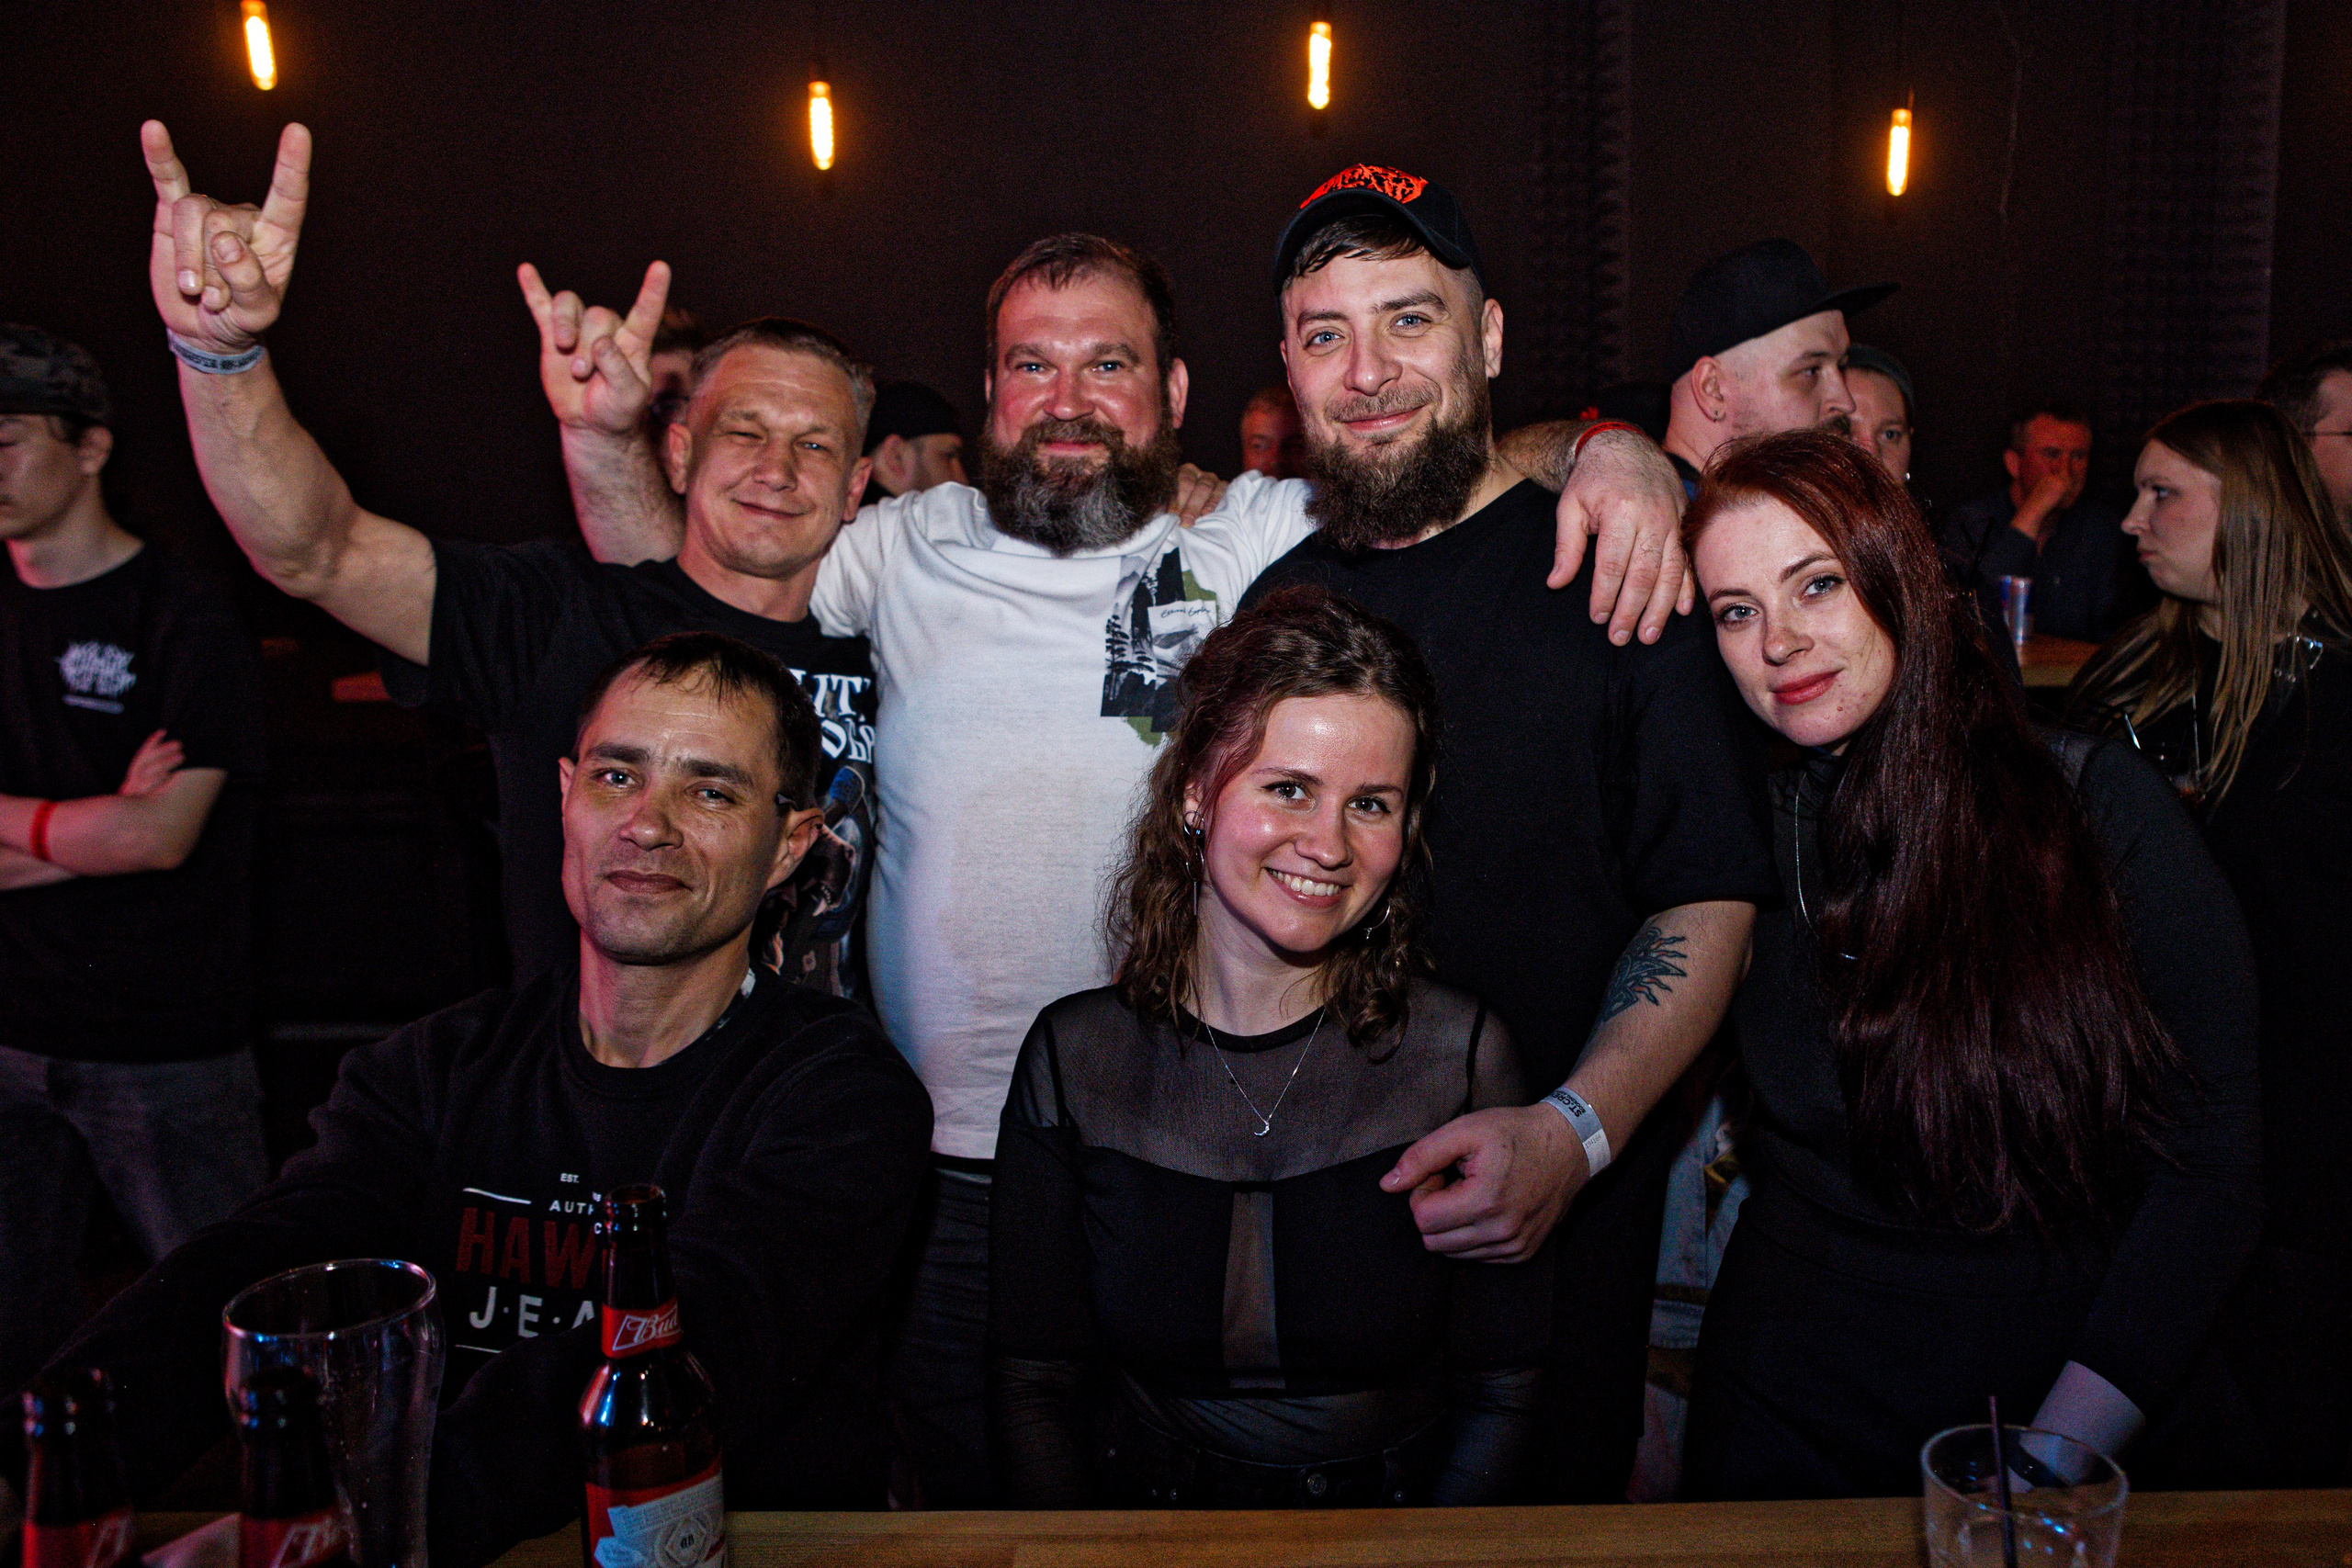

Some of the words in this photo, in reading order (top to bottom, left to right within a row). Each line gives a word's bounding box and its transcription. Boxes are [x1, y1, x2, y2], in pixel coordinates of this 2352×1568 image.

[560, 1173, 580, 1184] EST.
[456, 1207, 597, 1289] HAW
[627, 1310, 678, 1343] Bud
